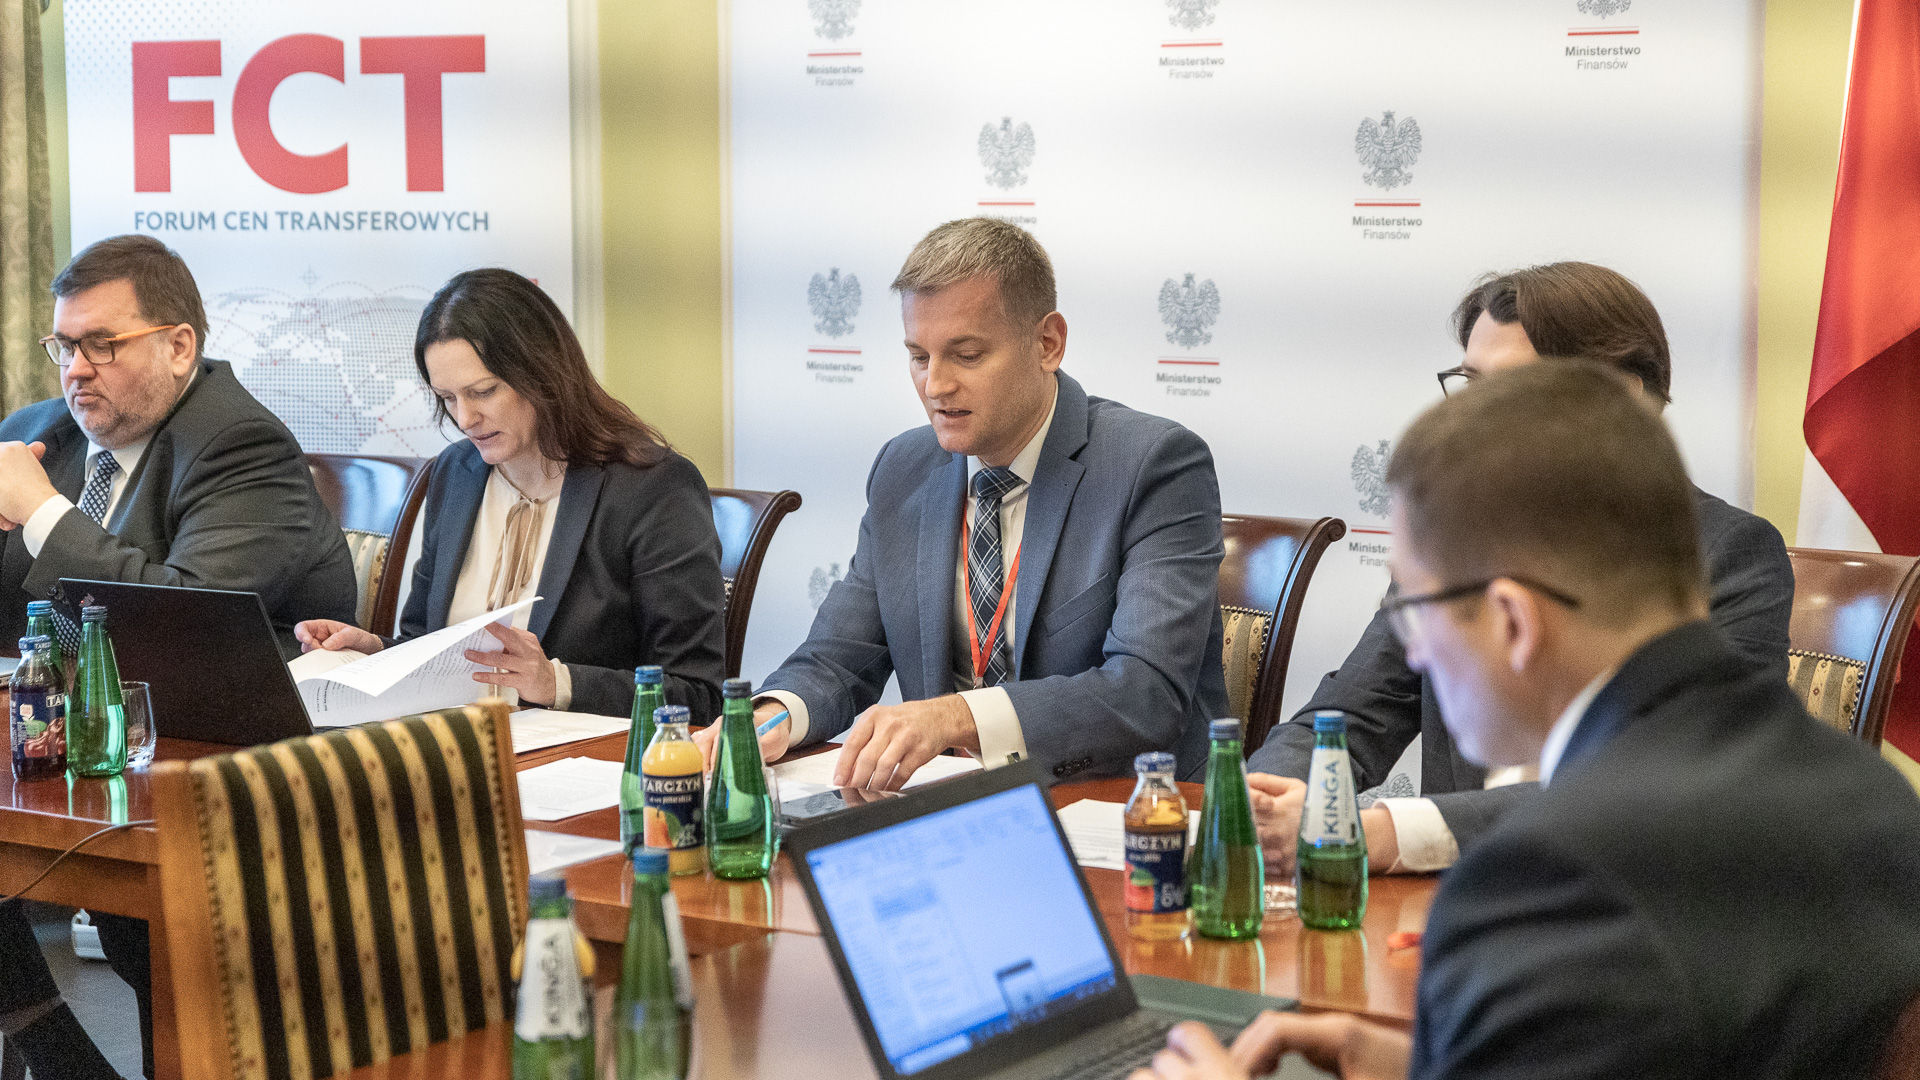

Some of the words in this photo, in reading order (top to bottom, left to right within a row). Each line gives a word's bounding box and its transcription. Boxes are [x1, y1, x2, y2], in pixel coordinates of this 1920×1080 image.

[1564, 45, 1641, 57] Ministerstwo
[1158, 56, 1225, 67] Ministerstwo
[1576, 57, 1629, 70] Finansów
[806, 65, 864, 75] Ministerstwo
[1168, 68, 1215, 80] Finansów
[131, 33, 486, 194] FCT
[134, 210, 216, 231] FORUM
[223, 210, 269, 231] CEN
[274, 210, 489, 231] TRANSFEROWYCH
[1352, 215, 1423, 227] Ministerstwo
[1363, 228, 1411, 240] Finansów
[806, 360, 864, 372] Ministerstwo
[1156, 372, 1222, 385] Ministerstwo
[1166, 384, 1211, 397] Finansów
[1348, 541, 1391, 554] Minister
[1360, 555, 1389, 567] Finan
[1324, 760, 1340, 835] KINGA
